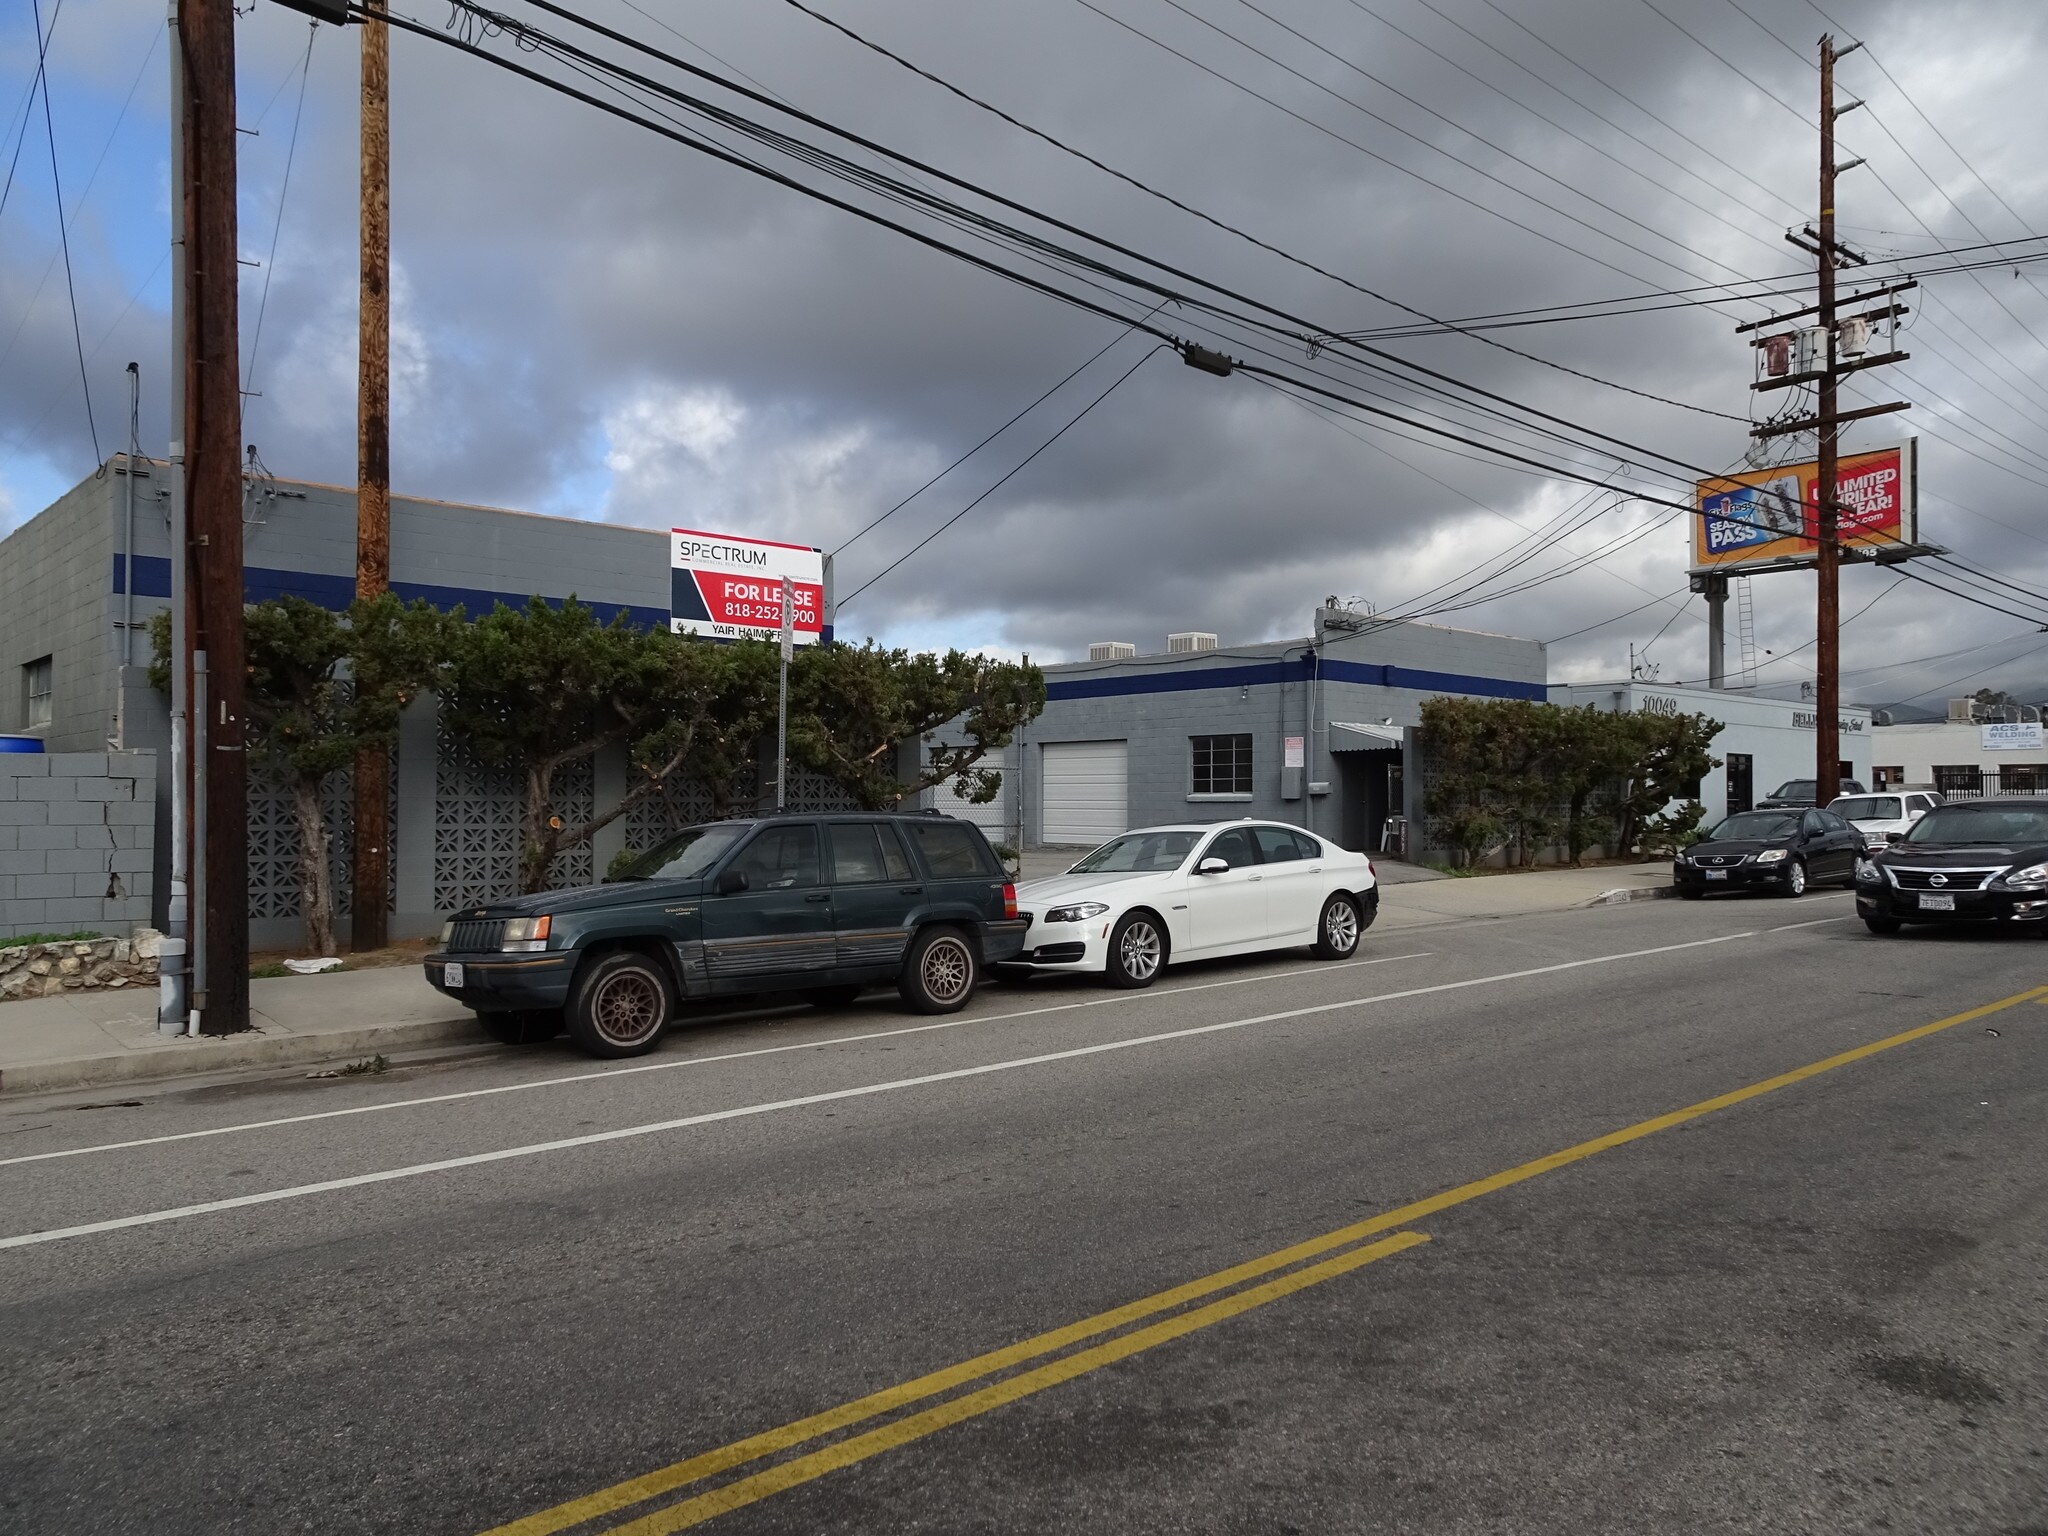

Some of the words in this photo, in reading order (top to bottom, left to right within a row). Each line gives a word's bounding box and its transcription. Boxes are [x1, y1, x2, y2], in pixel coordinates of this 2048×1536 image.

[1730, 501, 1752, 513] Flags
[1850, 494, 1893, 517] EAR!
[1710, 525, 1758, 549] PASS
[680, 541, 767, 566] SPECTRUM
[724, 582, 760, 601] FOR
[763, 586, 813, 607] LESE
[725, 602, 816, 624] 818-252-900
[712, 624, 735, 636] YAIR
[1642, 695, 1677, 717] 10049
[1989, 731, 2037, 739] WELDING
[1990, 724, 2019, 732] ACS
